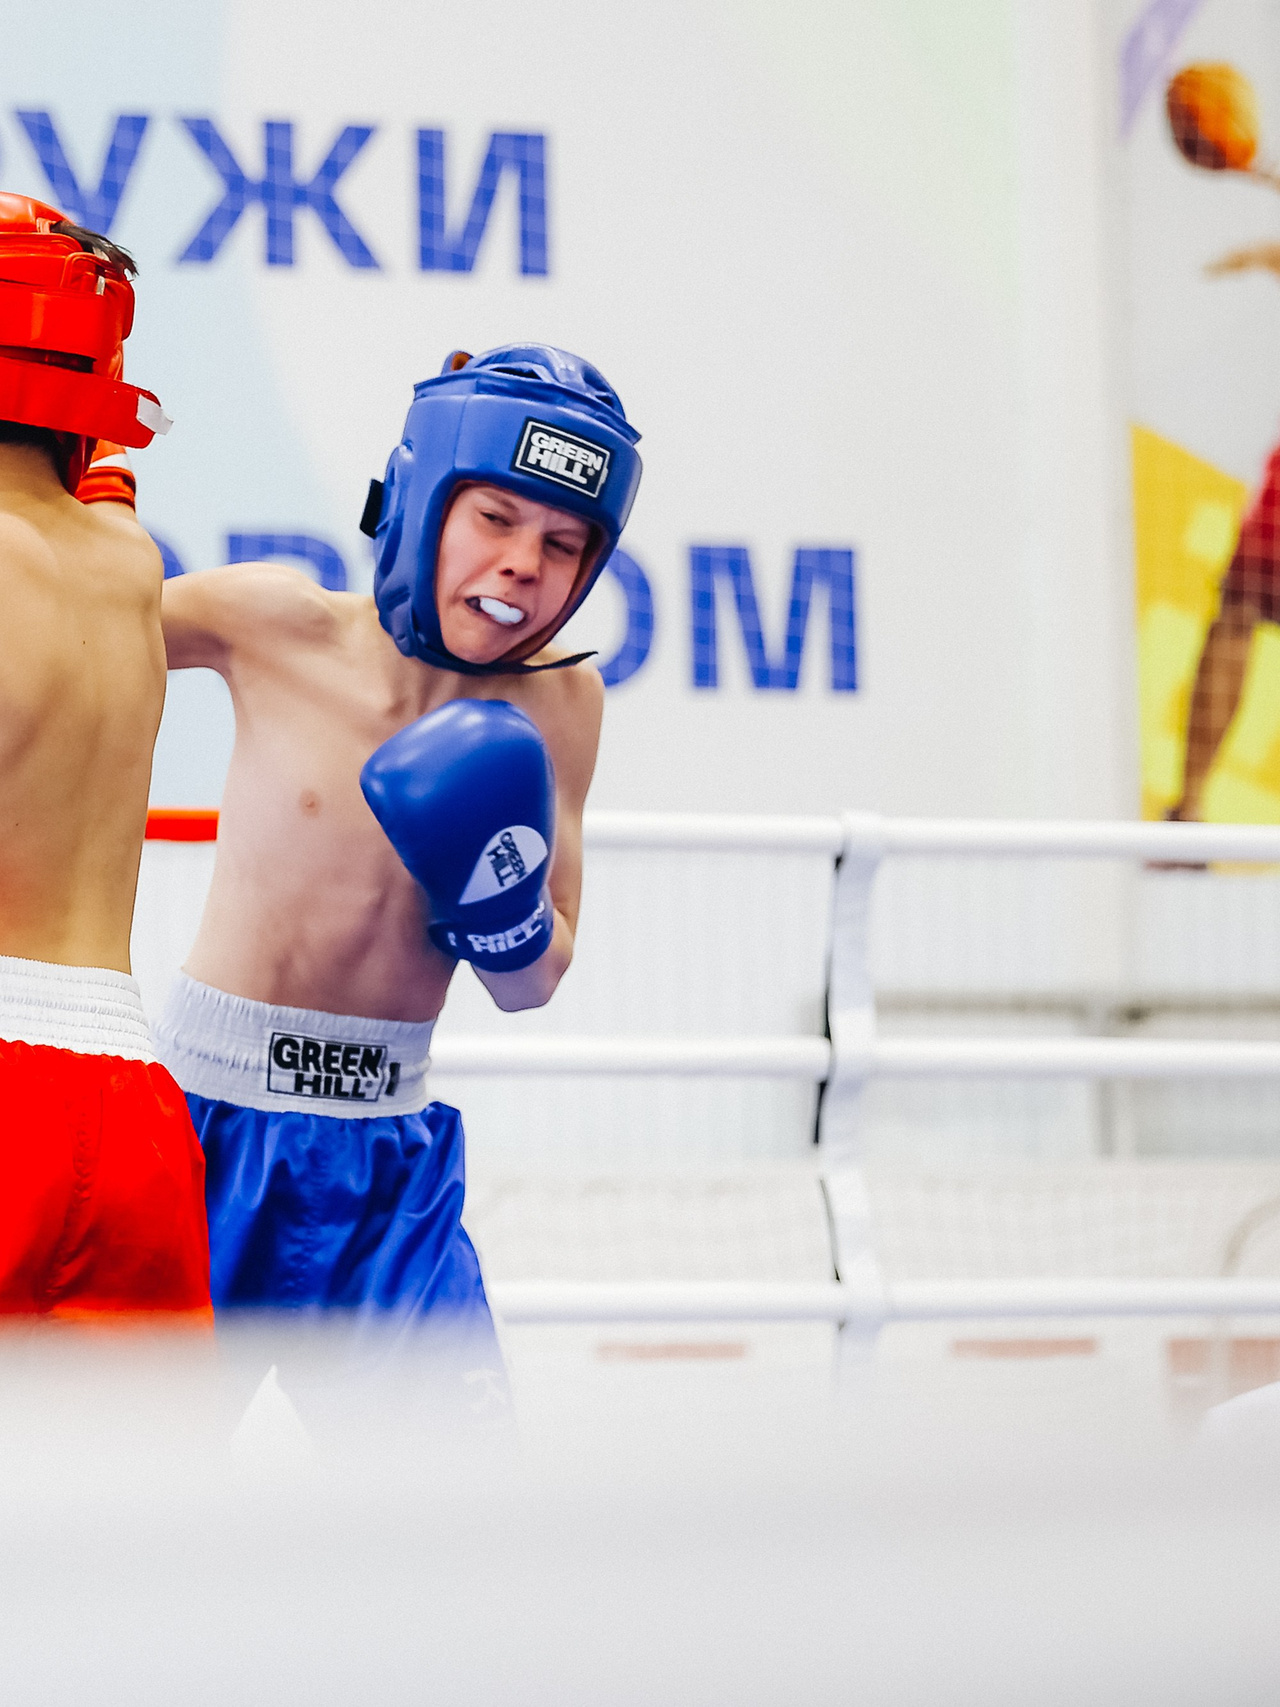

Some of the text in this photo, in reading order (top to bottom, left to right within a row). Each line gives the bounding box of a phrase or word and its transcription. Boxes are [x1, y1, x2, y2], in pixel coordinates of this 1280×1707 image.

[527, 445, 587, 484] HILL
[530, 431, 603, 471] GREEN
[273, 1037, 383, 1078] GREEN
[294, 1073, 366, 1098] HILL
